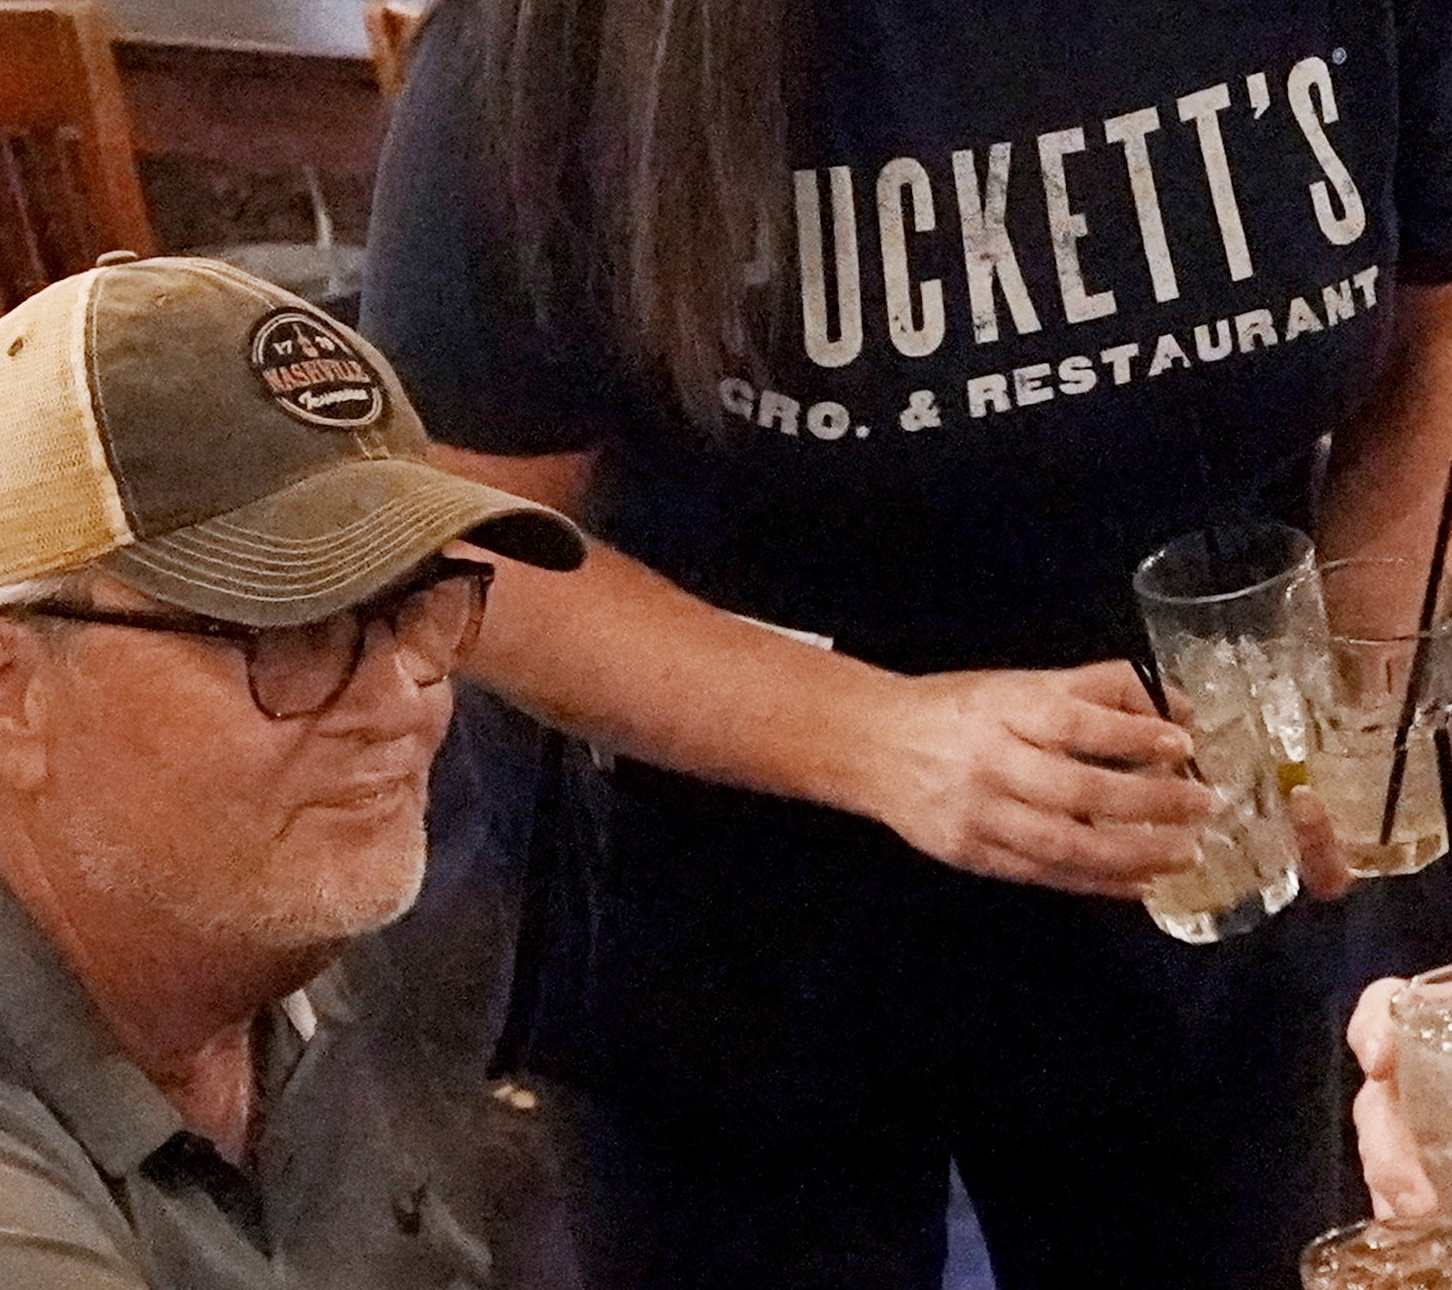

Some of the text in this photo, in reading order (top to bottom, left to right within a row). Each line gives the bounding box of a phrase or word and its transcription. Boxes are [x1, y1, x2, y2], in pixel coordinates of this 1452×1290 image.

[793, 55, 1366, 369] UCKETT'S
[900, 389, 942, 432] &
[966, 265, 1379, 419] RESTAURANT
